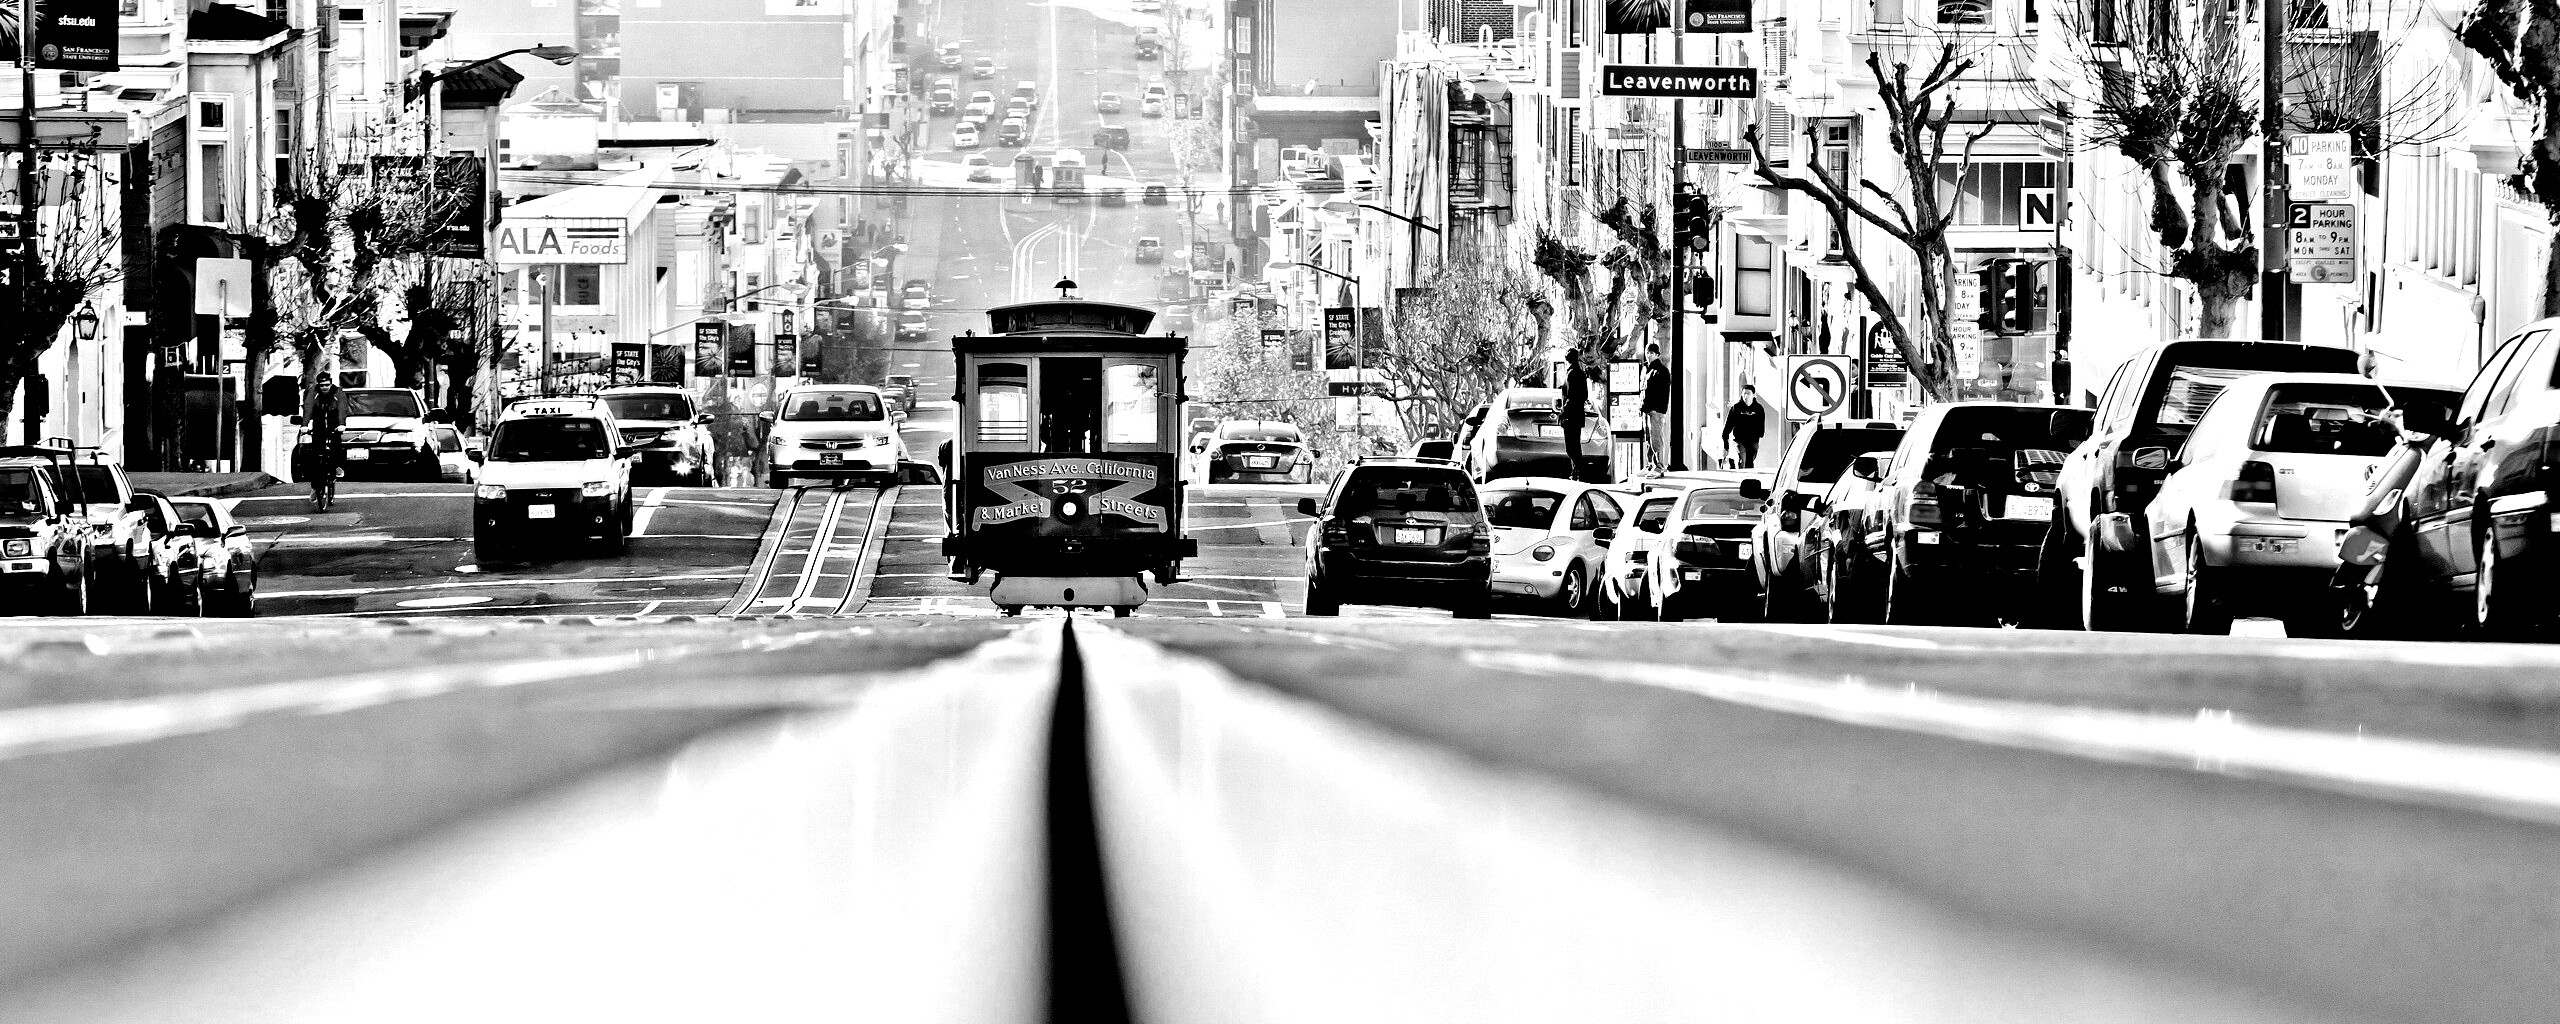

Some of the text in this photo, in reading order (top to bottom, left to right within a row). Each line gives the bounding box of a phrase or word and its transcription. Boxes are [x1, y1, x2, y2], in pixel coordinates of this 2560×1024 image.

[58, 15, 96, 26] sfsu.edu
[1609, 72, 1751, 91] Leavenworth
[2291, 137, 2347, 155] NO PARKING
[1688, 151, 1749, 162] LEAVENWORTH
[2303, 175, 2338, 185] MONDAY
[2026, 193, 2054, 224] N
[2294, 208, 2346, 224] 2 HOUR
[2312, 220, 2352, 228] PARKING
[571, 240, 619, 255] Foods
[2294, 247, 2314, 255] MON
[2334, 247, 2350, 255] SAT
[1611, 397, 1618, 406] 2
[1086, 461, 1155, 480] California
[1052, 479, 1087, 494] 52
[980, 502, 1044, 521] & Market
[1100, 498, 1158, 519] Streets
